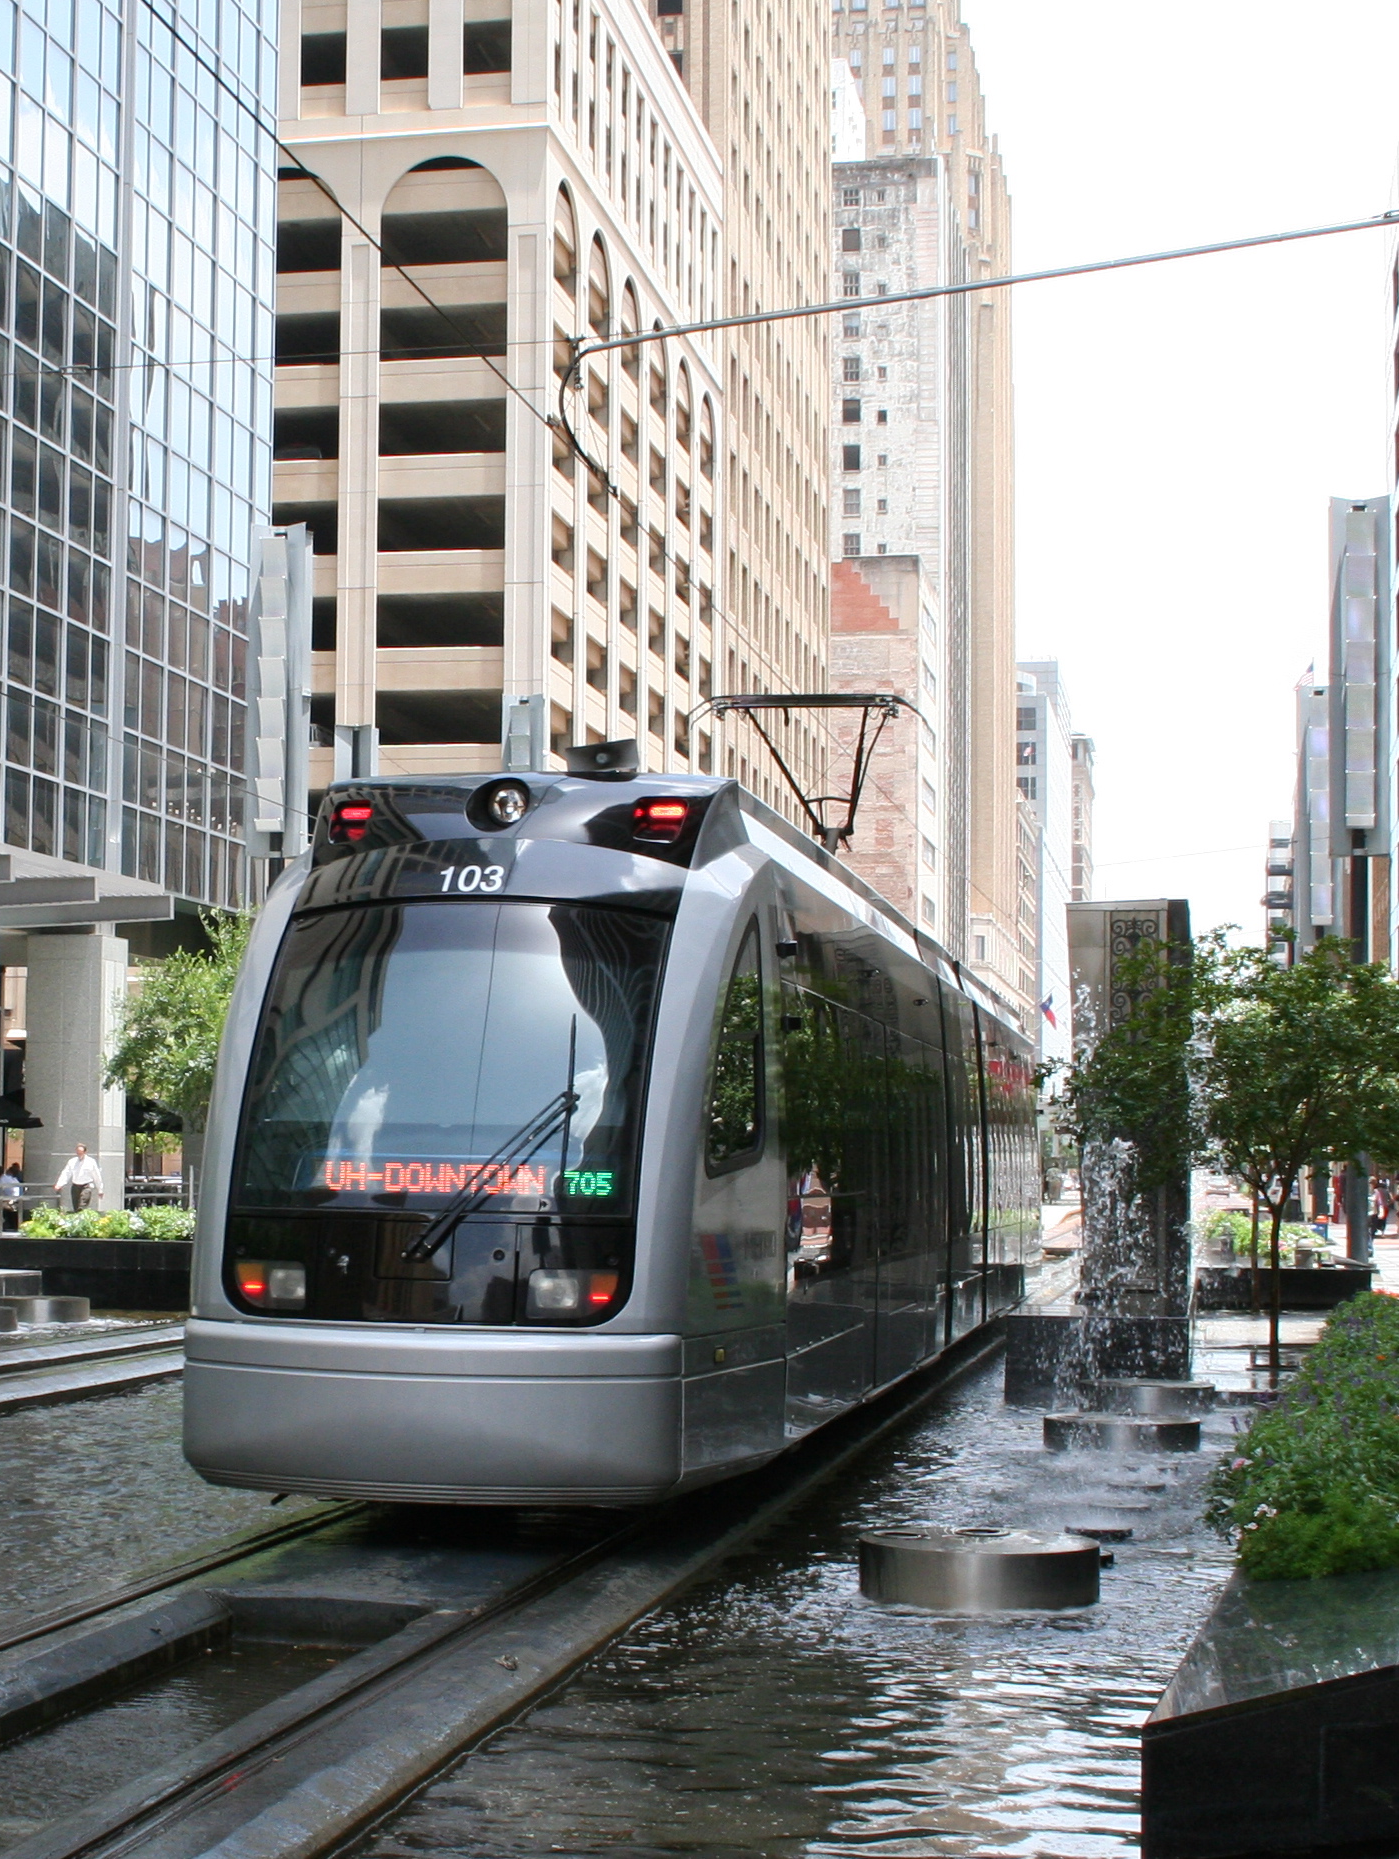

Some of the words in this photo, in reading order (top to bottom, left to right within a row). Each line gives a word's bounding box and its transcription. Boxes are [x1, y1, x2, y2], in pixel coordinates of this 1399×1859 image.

[440, 864, 504, 892] 103
[325, 1160, 545, 1195] UH-DOWNTOWN
[563, 1170, 614, 1197] 705
